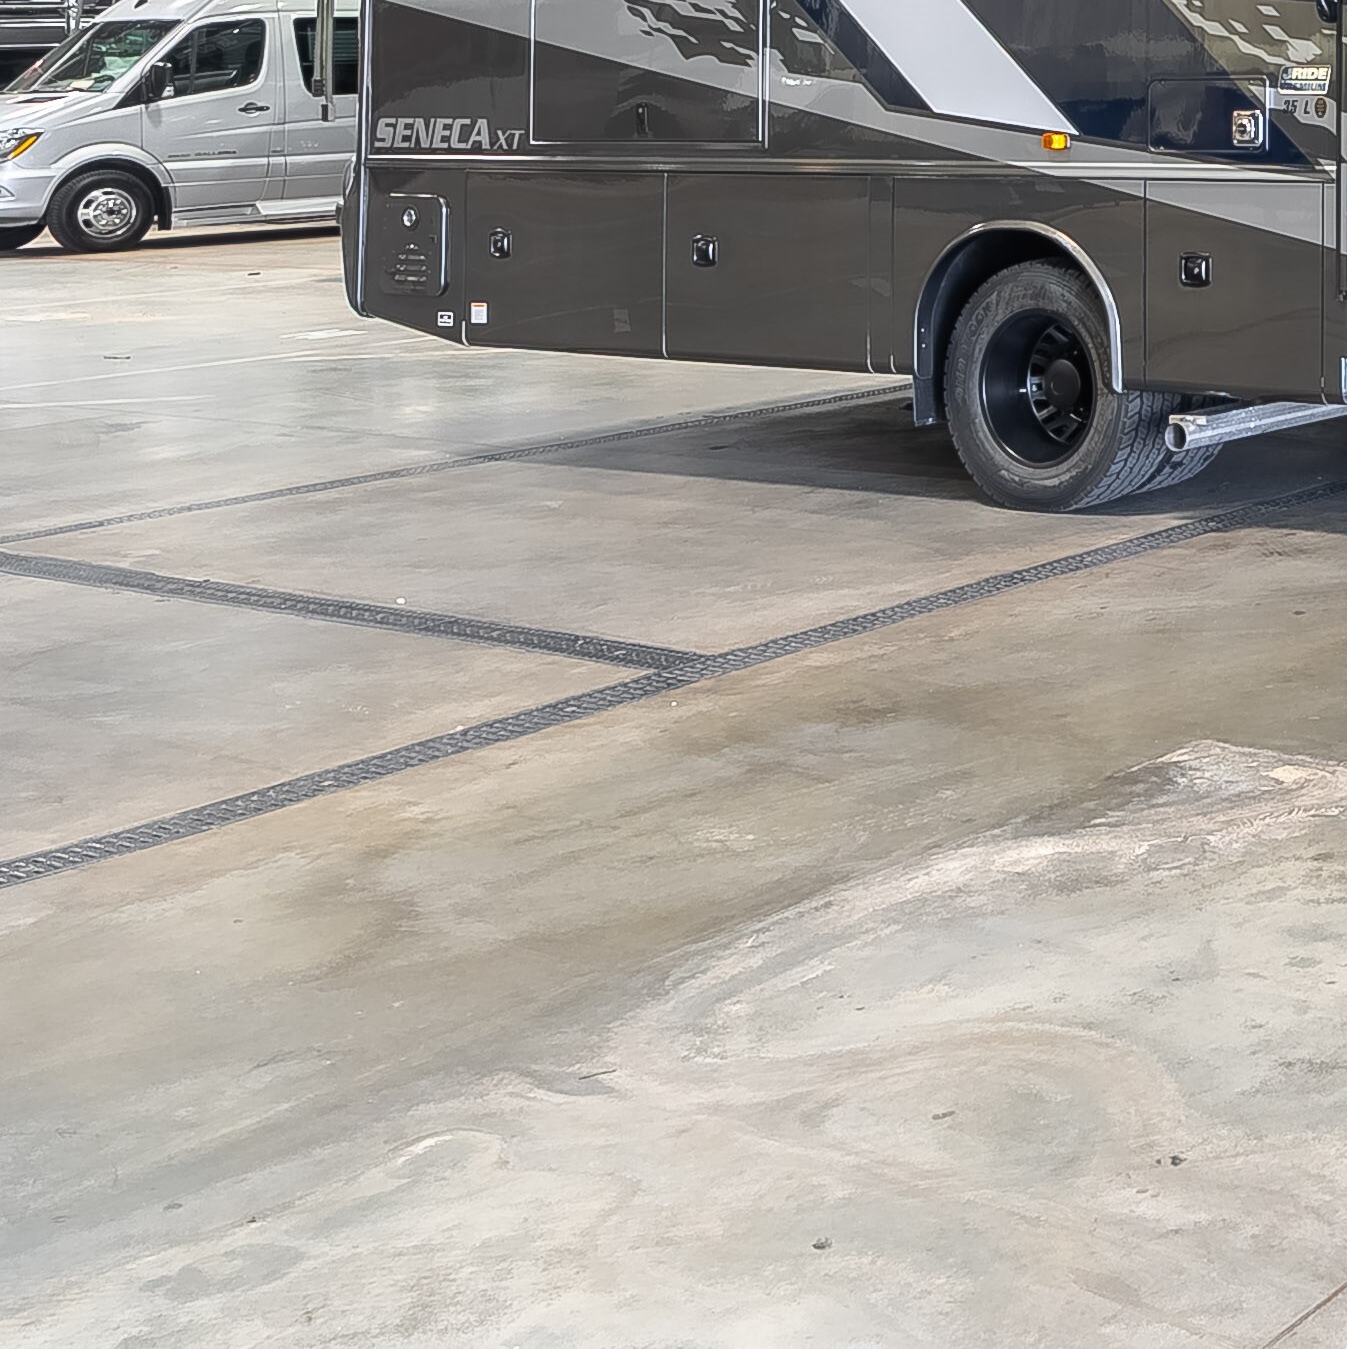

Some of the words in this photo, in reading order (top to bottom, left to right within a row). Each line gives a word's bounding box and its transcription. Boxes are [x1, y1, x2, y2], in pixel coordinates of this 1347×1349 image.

[1283, 100, 1299, 114] 35
[374, 117, 491, 150] SENECA
[492, 130, 526, 150] XT
